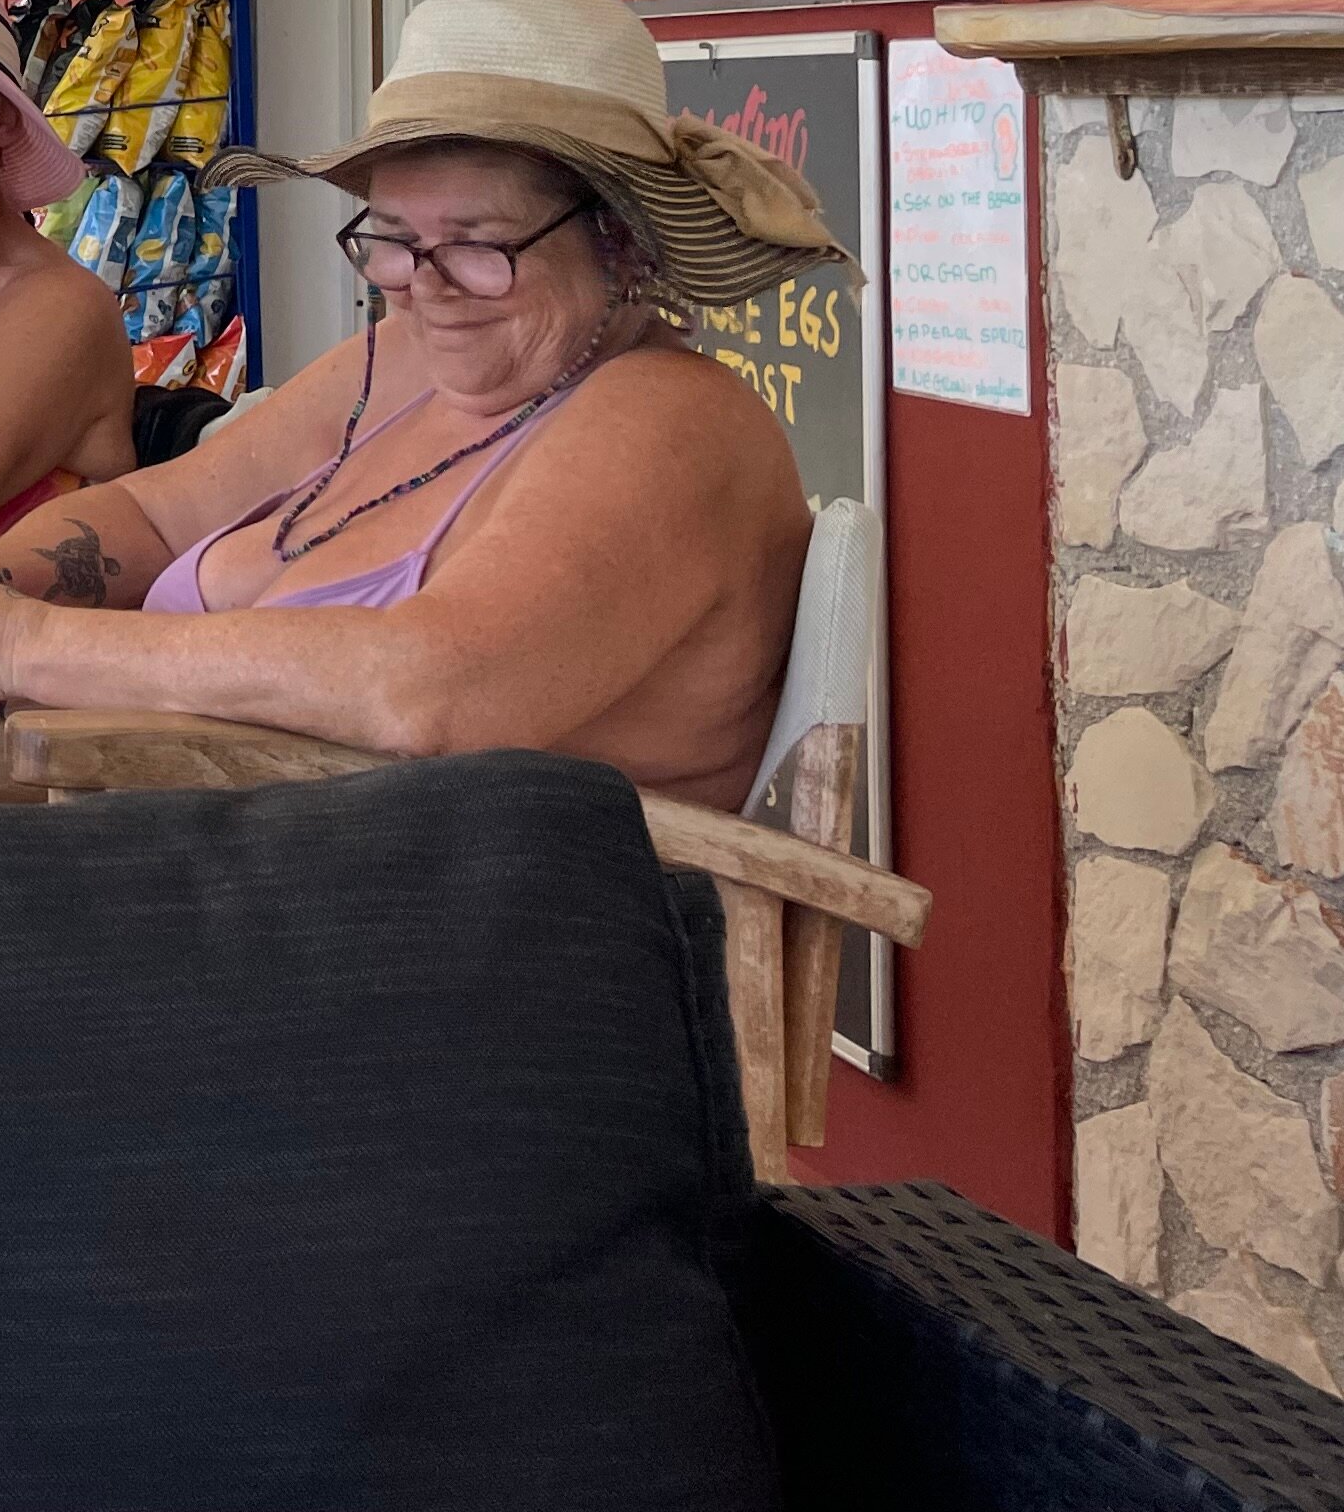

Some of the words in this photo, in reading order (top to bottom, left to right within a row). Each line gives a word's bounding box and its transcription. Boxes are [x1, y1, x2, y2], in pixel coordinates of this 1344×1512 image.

[904, 193, 930, 211] SEX
[938, 195, 954, 208] ON
[962, 192, 980, 205] THE
[908, 262, 996, 283] ORGASM
[779, 278, 840, 359] EGS
